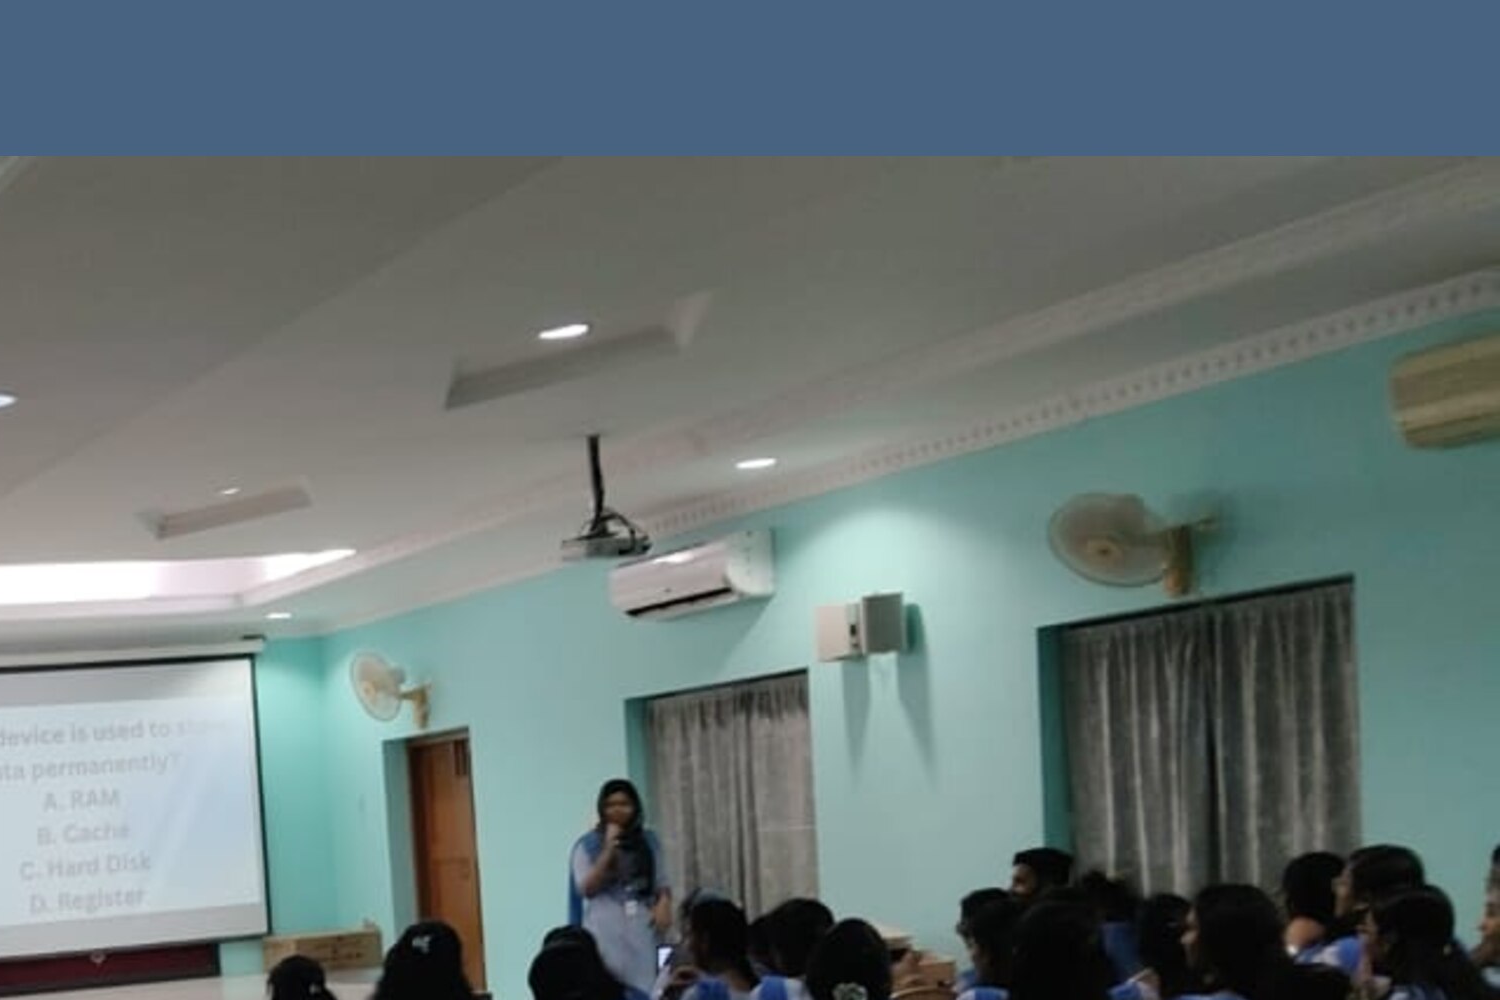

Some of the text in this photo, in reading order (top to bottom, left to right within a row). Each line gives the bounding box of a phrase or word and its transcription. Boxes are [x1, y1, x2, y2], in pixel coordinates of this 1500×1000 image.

[70, 721, 89, 743] is
[93, 718, 145, 741] used
[149, 720, 171, 738] to
[70, 789, 121, 810] RAM
[62, 821, 130, 844] Cache
[48, 855, 100, 877] Hard
[106, 850, 152, 874] Disk
[57, 887, 145, 914] Register
